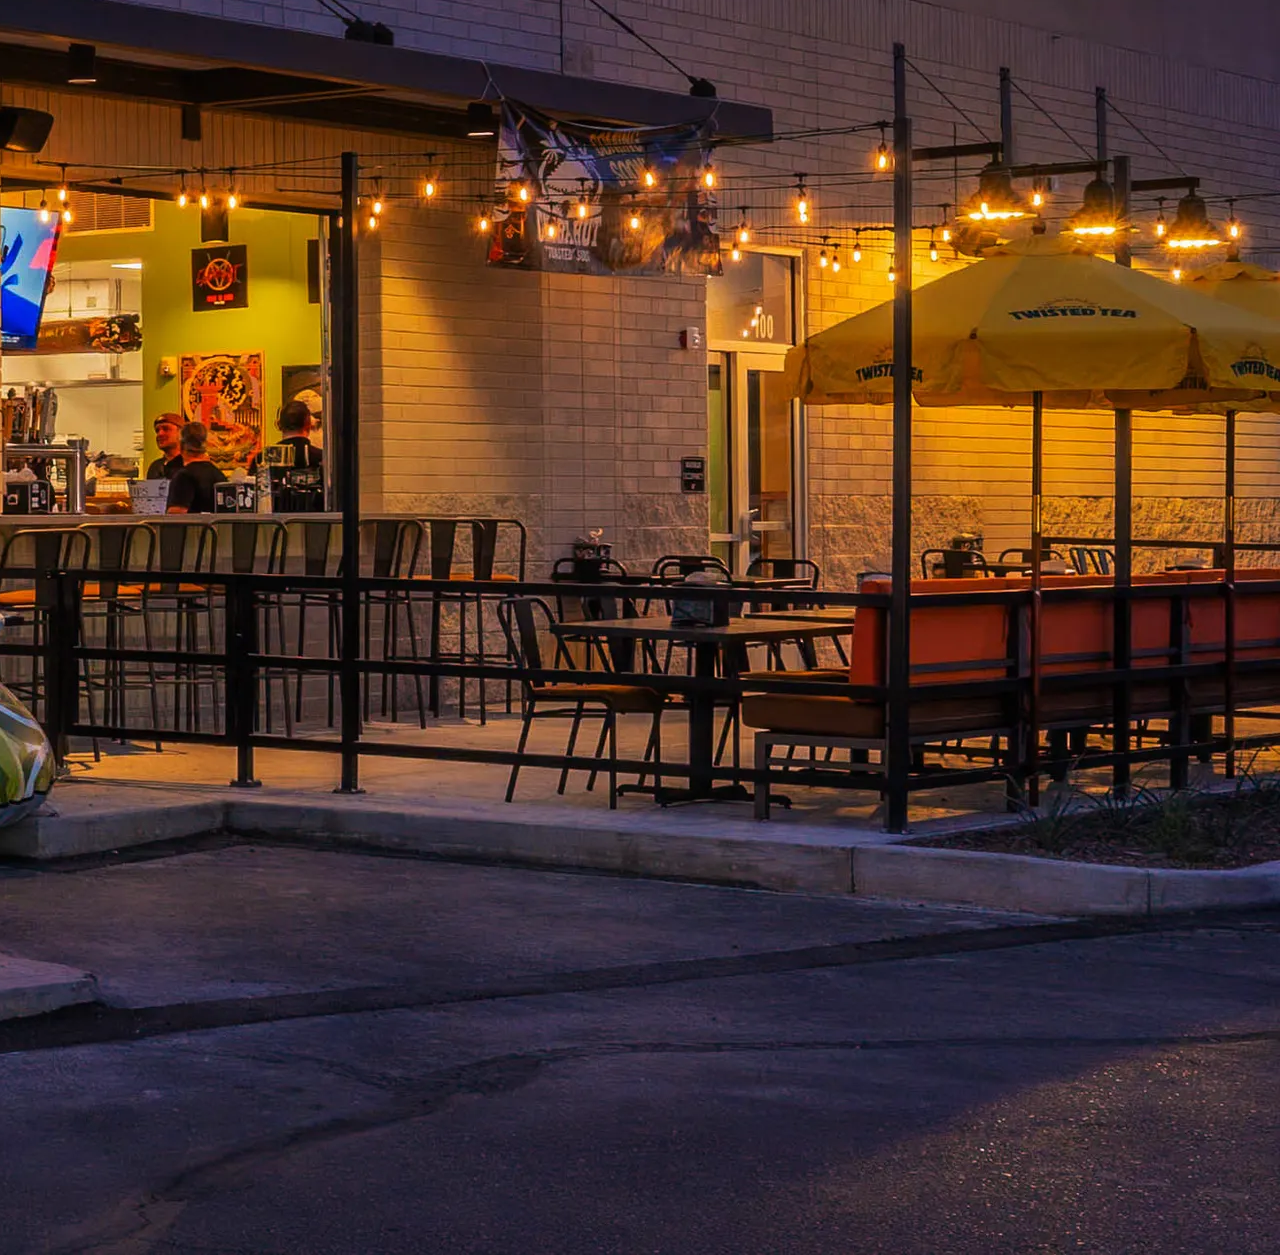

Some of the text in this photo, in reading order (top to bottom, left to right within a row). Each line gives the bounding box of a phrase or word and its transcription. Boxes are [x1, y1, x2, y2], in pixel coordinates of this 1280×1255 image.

[1008, 307, 1096, 321] TWISTED
[1099, 306, 1137, 319] TEA
[755, 314, 773, 339] 100
[856, 363, 894, 382] TWIST
